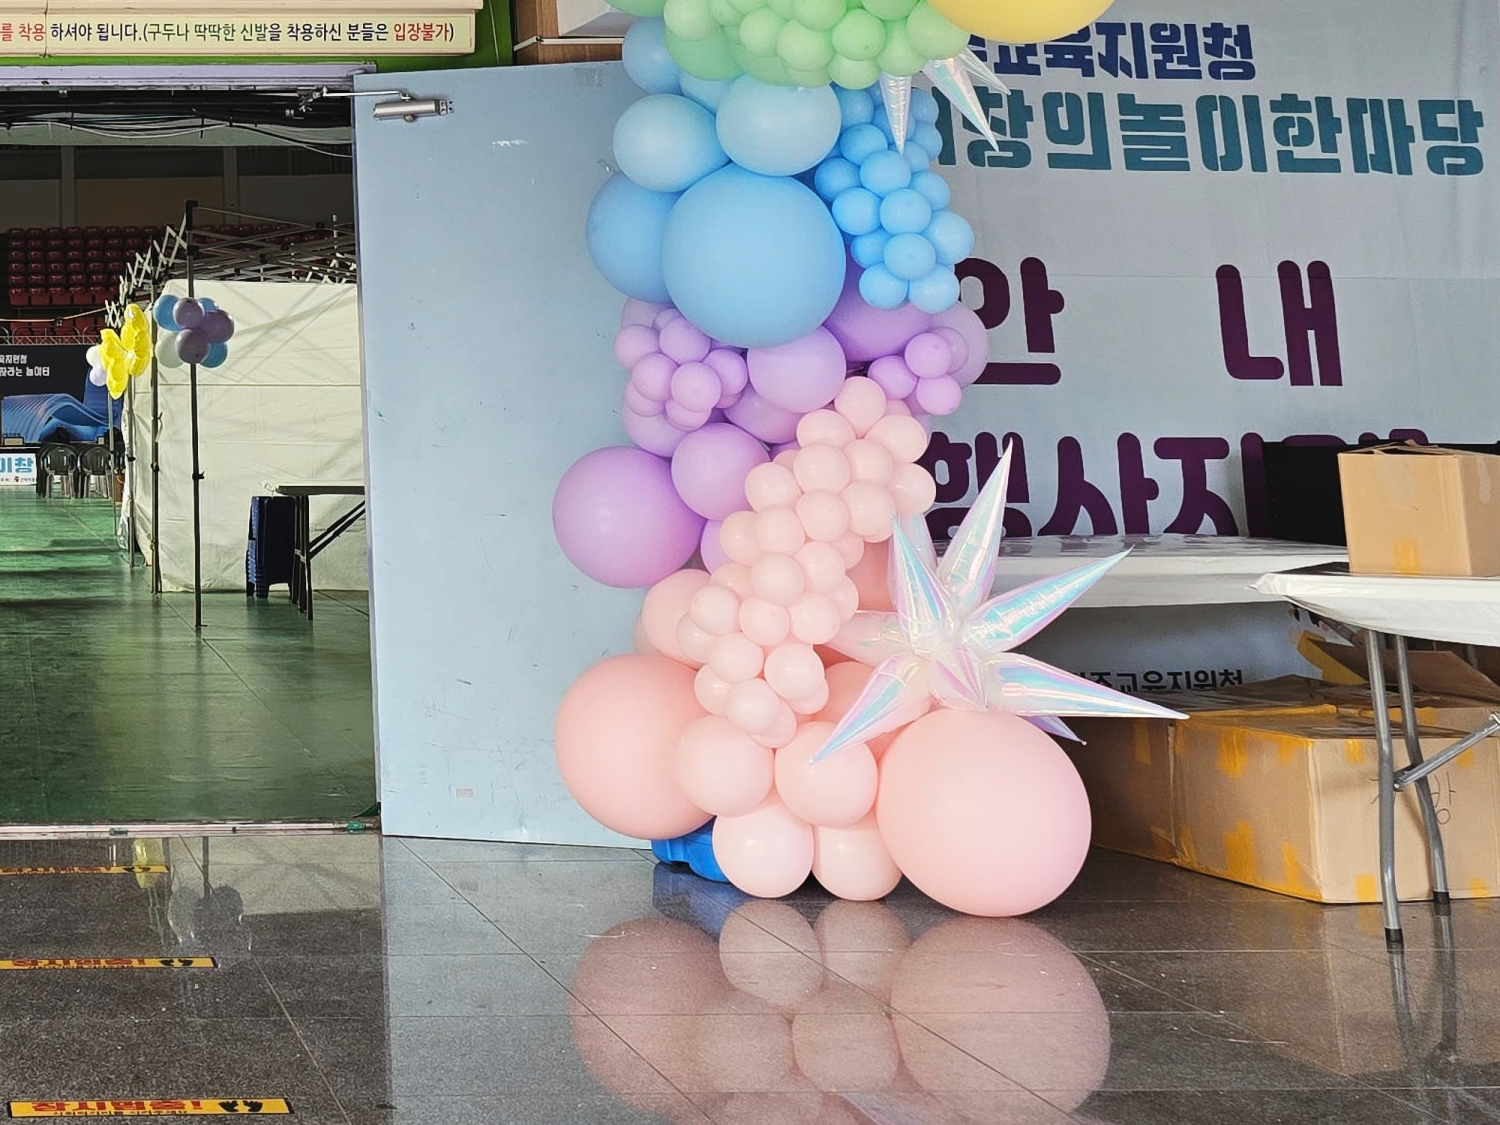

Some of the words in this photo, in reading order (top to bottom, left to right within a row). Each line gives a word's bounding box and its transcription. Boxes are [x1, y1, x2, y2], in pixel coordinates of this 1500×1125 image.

[18, 23, 46, 42] 착용
[50, 23, 93, 43] 하셔야
[194, 23, 236, 43] 딱딱한
[240, 22, 282, 43] 신발을
[286, 22, 342, 43] 착용하신
[346, 22, 389, 43] 분들은
[393, 22, 455, 43] 입장불가)
[954, 257, 1065, 385] 안
[1215, 260, 1343, 386] 내
[923, 429, 1428, 540] 행사지
[1074, 668, 1243, 693] 교육지원청
